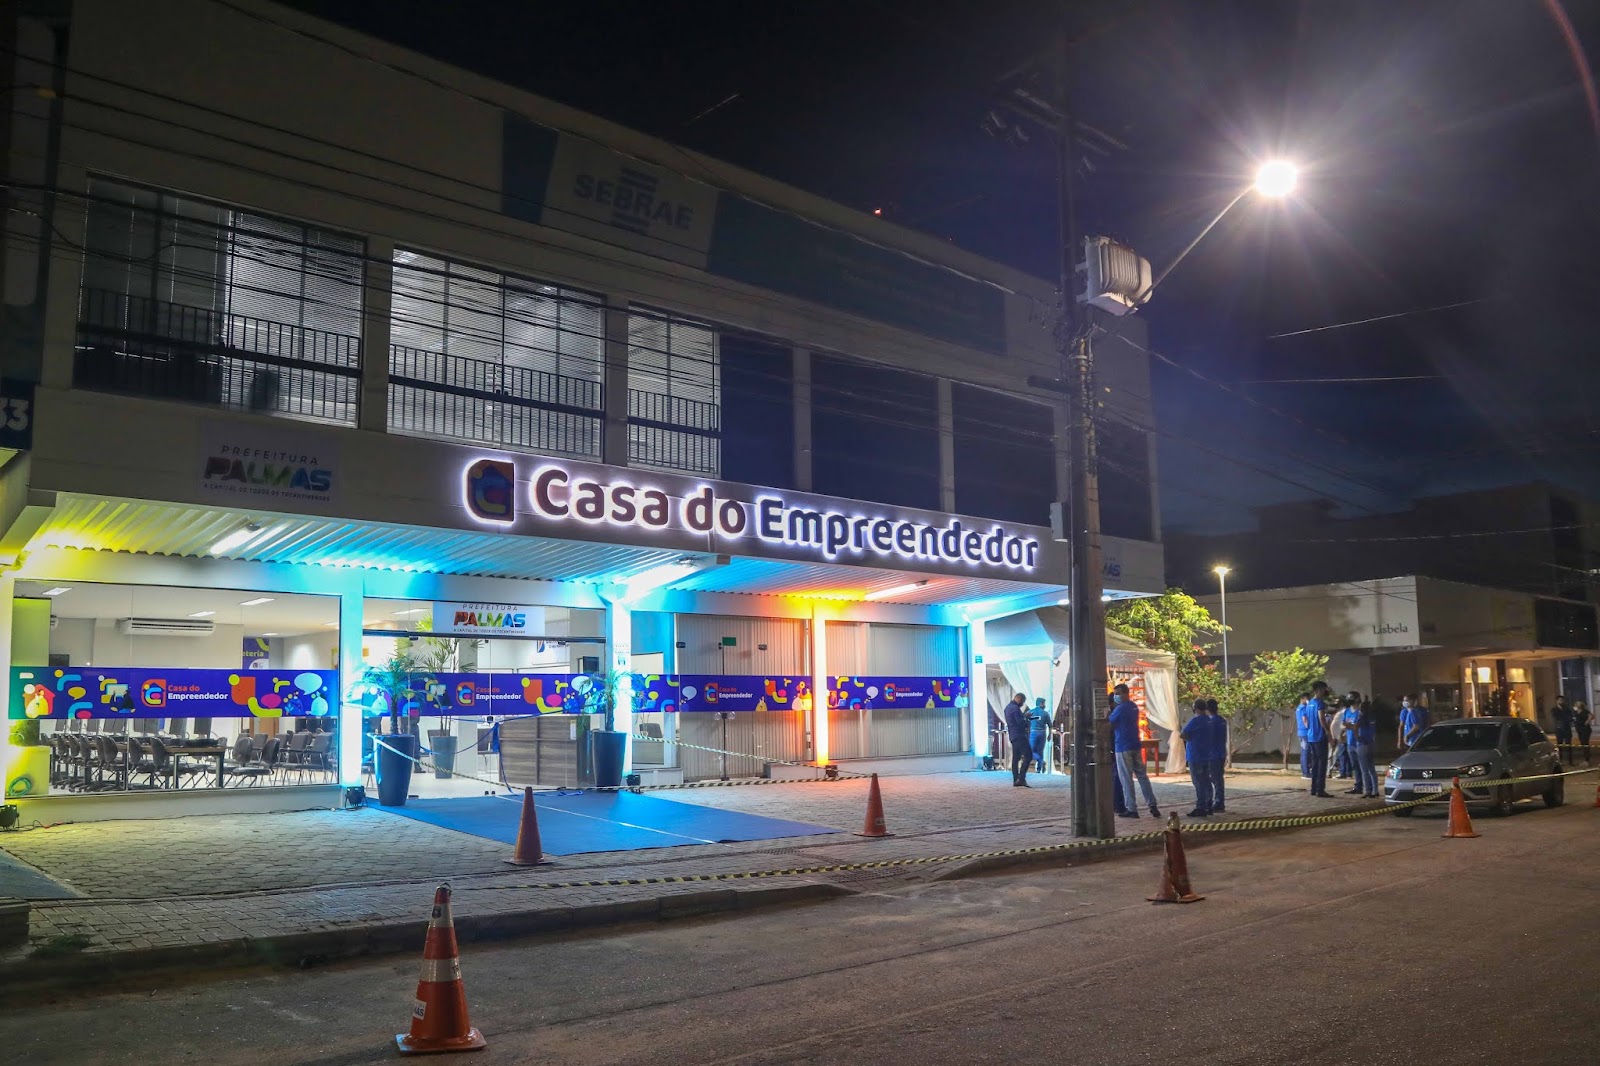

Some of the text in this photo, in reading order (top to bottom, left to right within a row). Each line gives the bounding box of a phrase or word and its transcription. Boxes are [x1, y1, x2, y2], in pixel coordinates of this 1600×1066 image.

[574, 174, 693, 230] SEBRAE
[221, 445, 319, 466] PREFEITURA
[204, 456, 332, 492] PALMAS
[535, 467, 1038, 567] Casa do Empreendedor
[462, 603, 518, 612] PREFEITURA
[453, 611, 526, 628] PALMAS
[1373, 622, 1408, 635] Lisbela
[167, 692, 228, 702] Empreendedor
